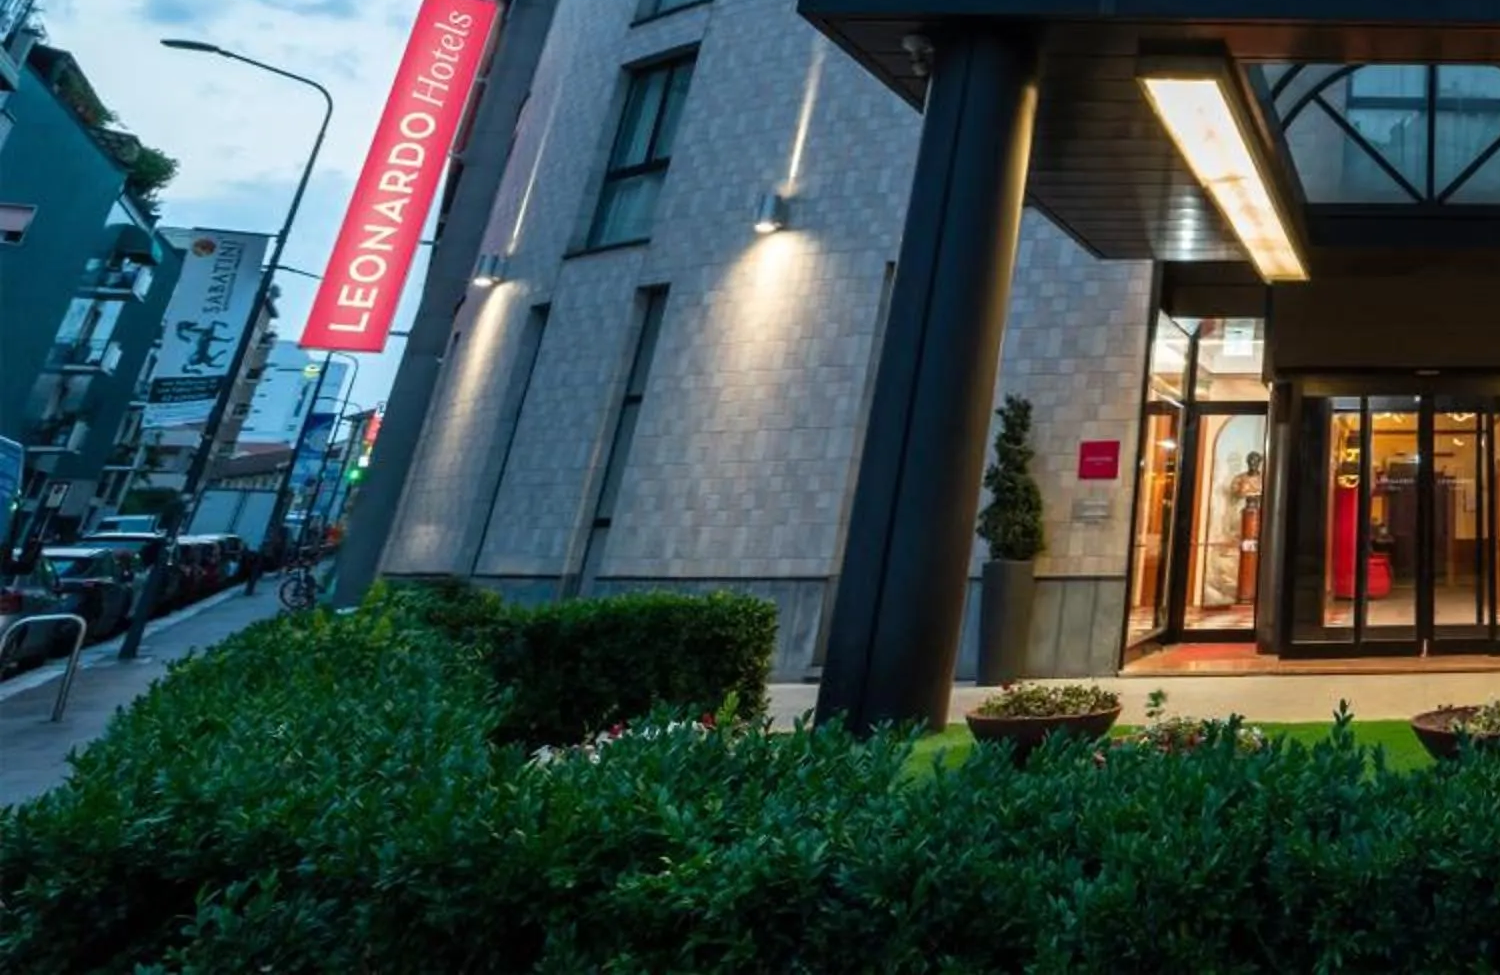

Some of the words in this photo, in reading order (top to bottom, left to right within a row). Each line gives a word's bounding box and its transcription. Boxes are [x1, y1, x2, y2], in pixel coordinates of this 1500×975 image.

[328, 111, 436, 334] LEONARDO
[411, 10, 473, 107] Hotels
[203, 239, 239, 314] SABATINI
